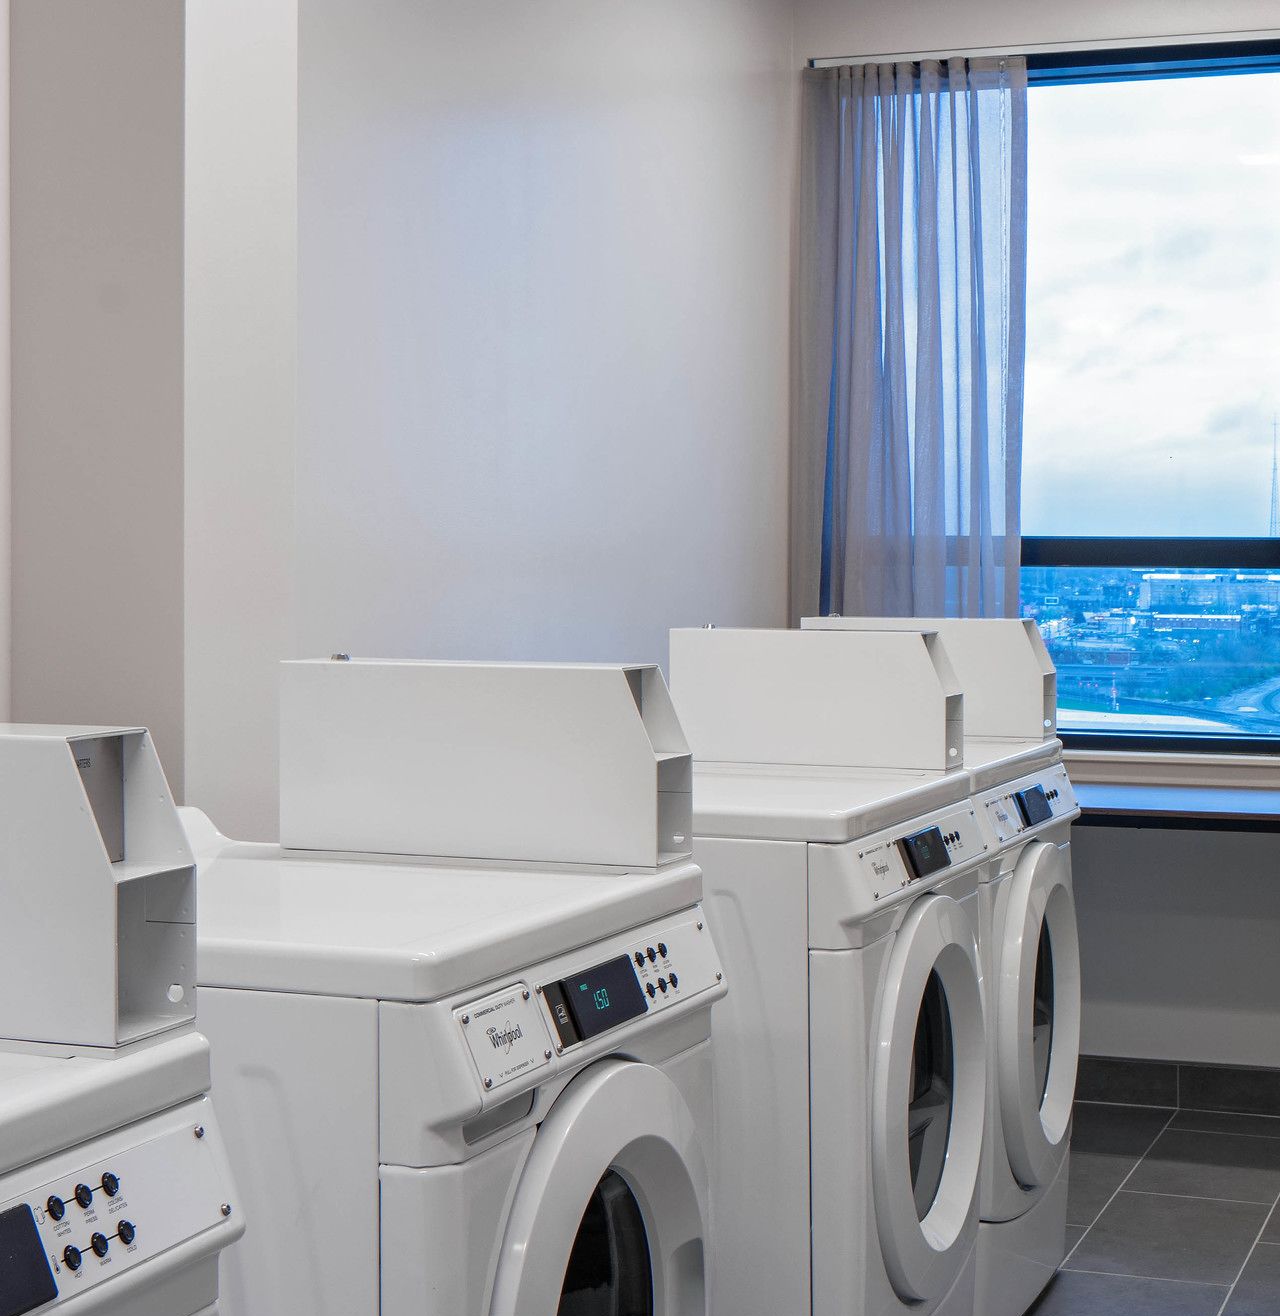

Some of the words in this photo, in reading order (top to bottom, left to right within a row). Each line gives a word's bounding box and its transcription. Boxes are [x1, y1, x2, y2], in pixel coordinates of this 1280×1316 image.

[488, 1023, 524, 1049] Whirlpool
[127, 1245, 138, 1254] COLD
[74, 1271, 83, 1279] HOT
